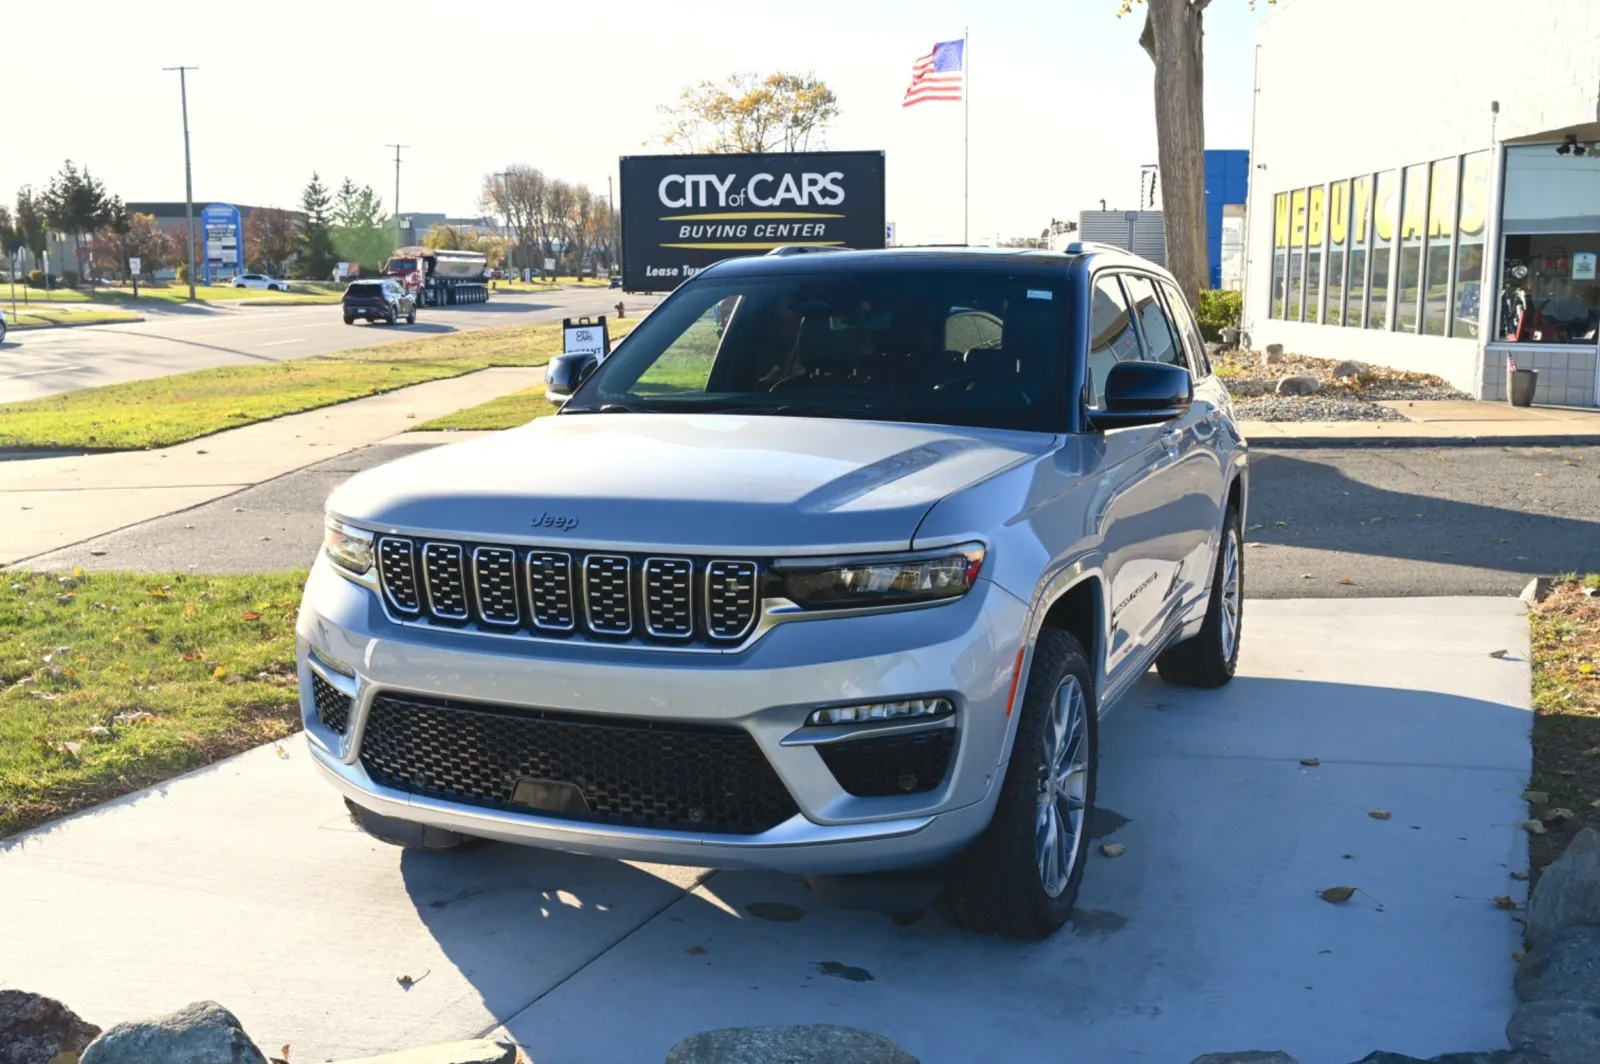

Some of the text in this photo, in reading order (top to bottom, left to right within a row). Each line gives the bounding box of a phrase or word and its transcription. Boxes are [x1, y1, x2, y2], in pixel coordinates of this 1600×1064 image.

[658, 172, 845, 208] CITY of CARS
[1274, 189, 1305, 249] WE
[1308, 180, 1367, 248] BUY
[679, 224, 825, 238] BUYING CENTER
[646, 265, 678, 276] Lease
[531, 512, 579, 531] Jeep
